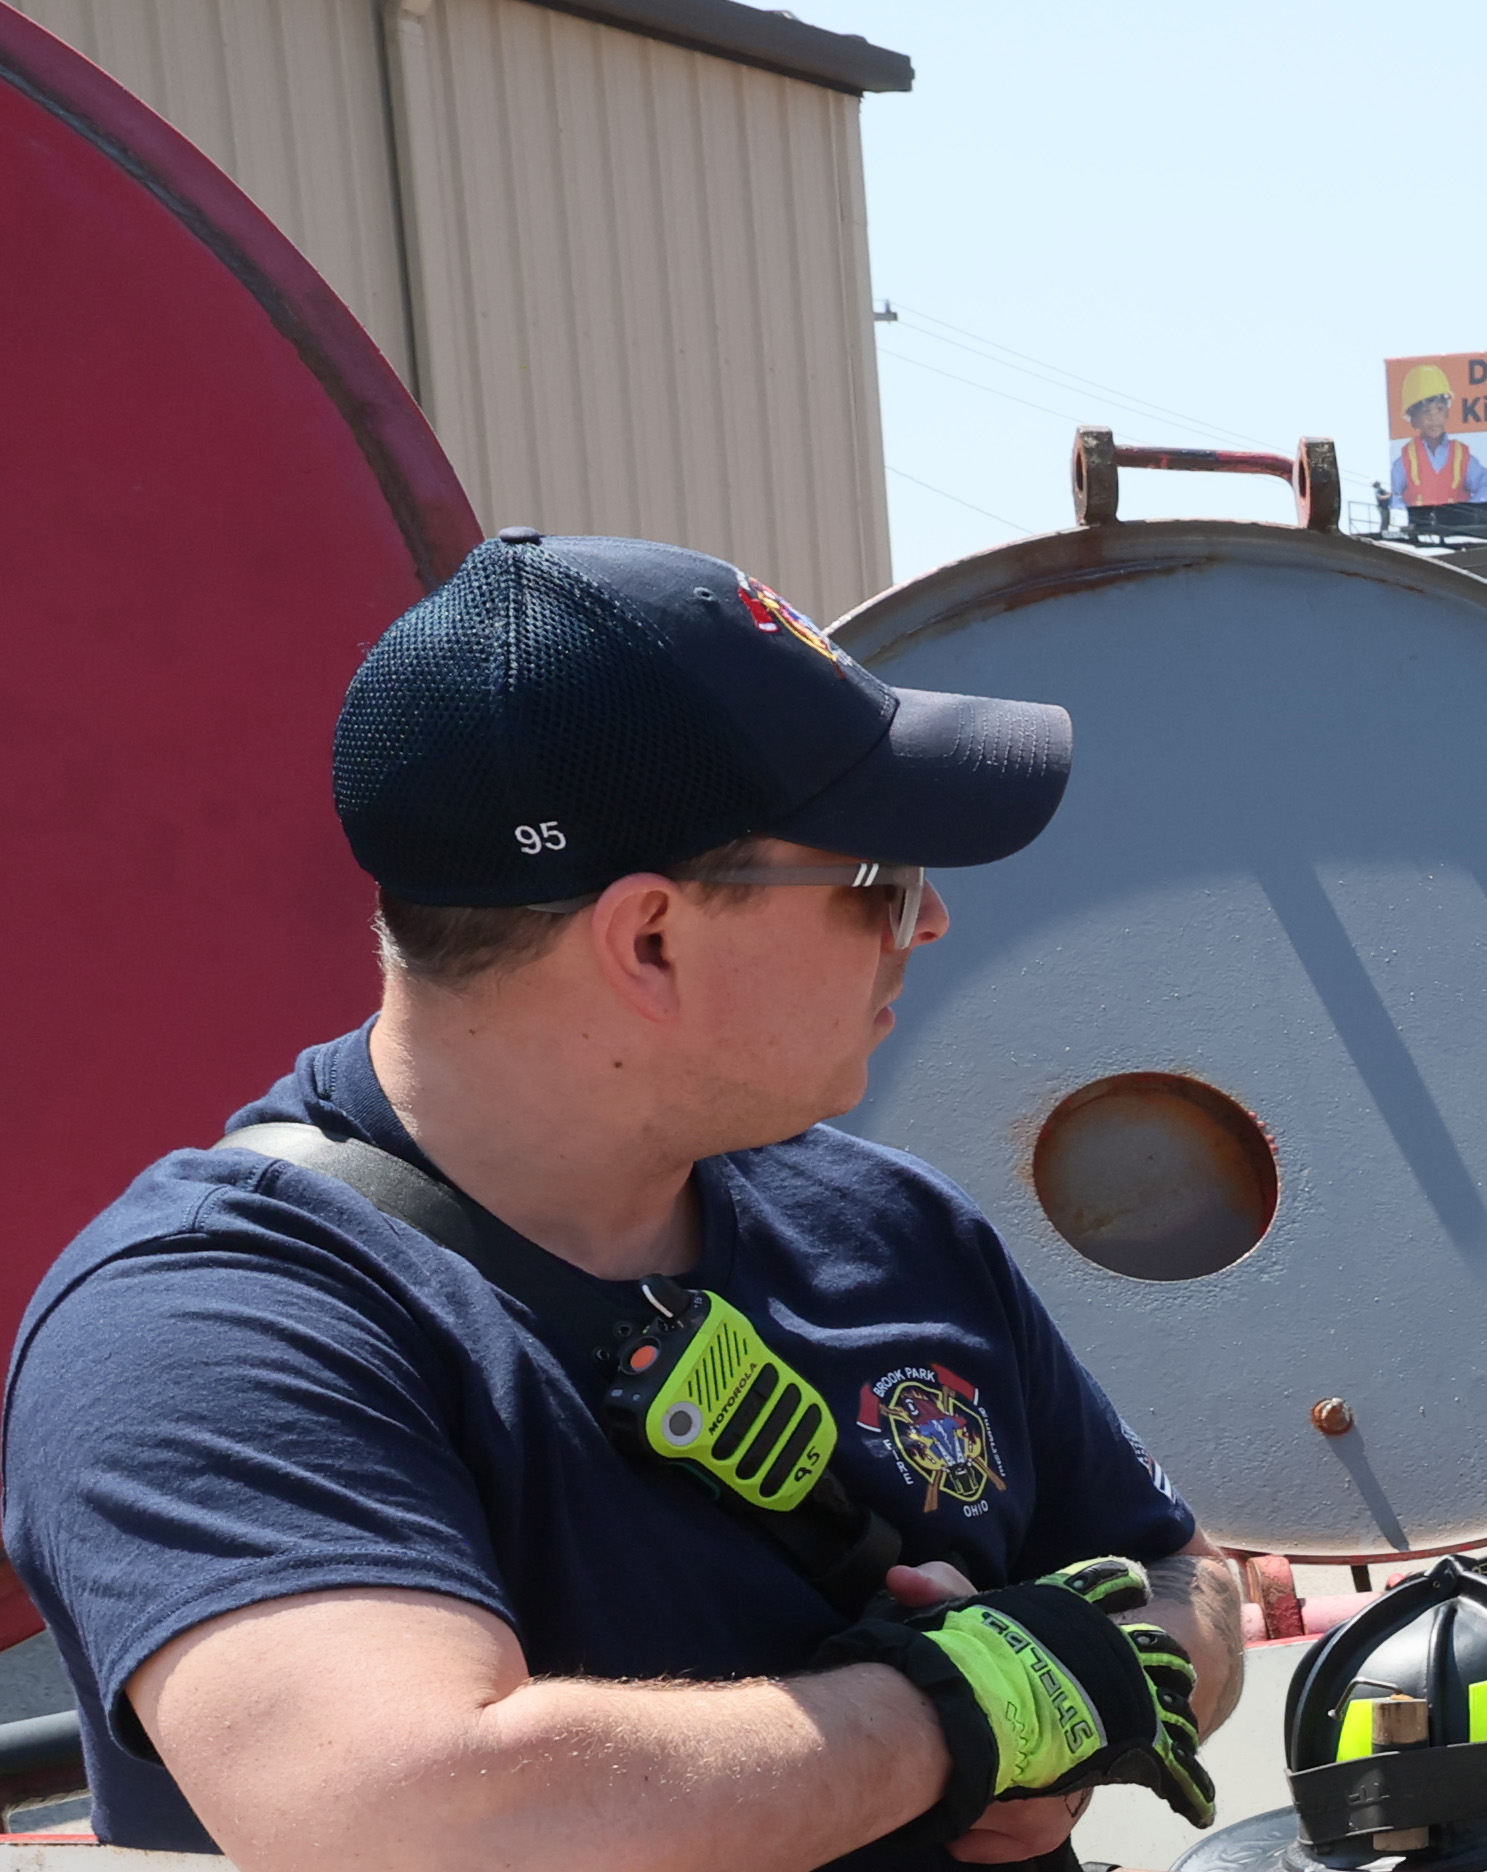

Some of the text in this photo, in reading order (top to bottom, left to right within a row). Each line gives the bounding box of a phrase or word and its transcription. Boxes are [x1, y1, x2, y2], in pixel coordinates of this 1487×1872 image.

[514, 820, 567, 854] 95
[708, 1362, 757, 1435] MOTOROLA
[873, 1366, 936, 1398] BROOK PARK
[794, 1446, 820, 1482] 95
[882, 1438, 914, 1485] FIRE
[963, 1499, 989, 1517] OHIO
